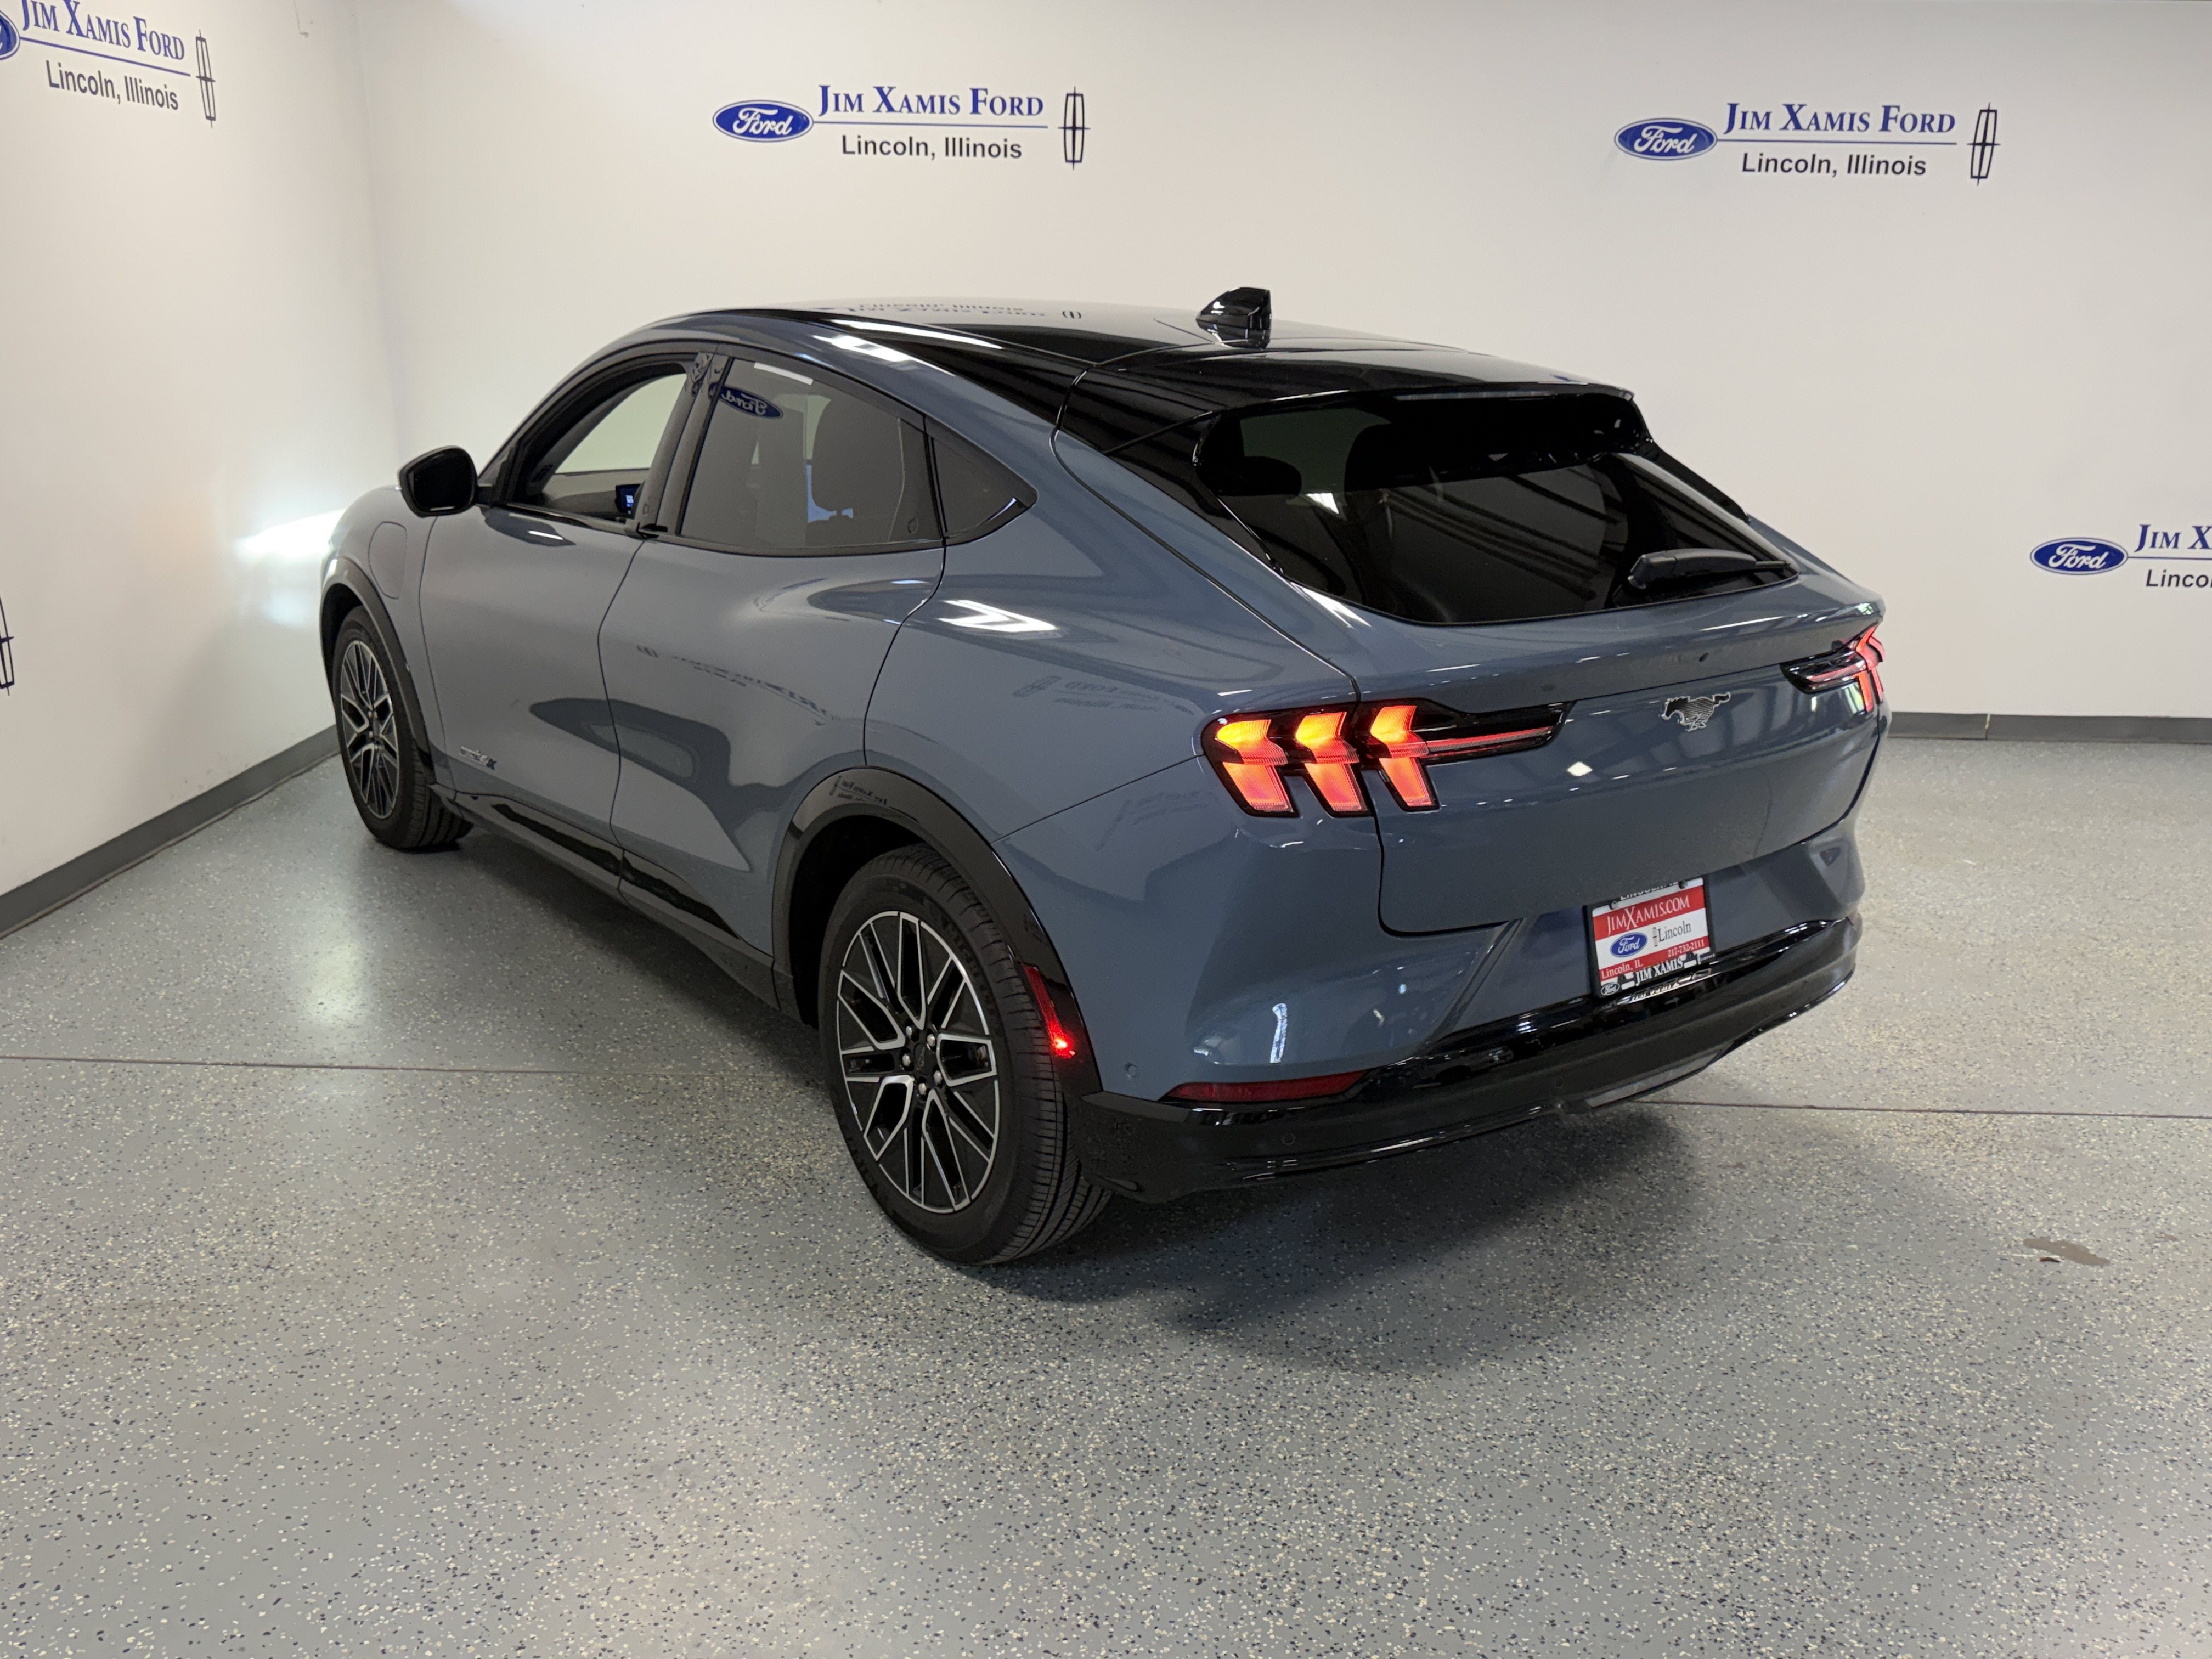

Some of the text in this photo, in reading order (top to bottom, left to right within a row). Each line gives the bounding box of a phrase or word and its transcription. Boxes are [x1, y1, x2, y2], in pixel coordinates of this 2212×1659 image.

[21, 0, 185, 60] JIM XAMIS FORD
[46, 60, 179, 111] Lincoln, Illinois
[818, 84, 1044, 117] JIM XAMIS FORD
[732, 107, 794, 136] Ford
[1723, 103, 1955, 135] JIM XAMIS FORD
[842, 134, 1022, 161] Lincoln, Illinois
[1634, 125, 1698, 153] Ford
[1742, 152, 1926, 178] Lincoln, Illinois
[2134, 524, 2181, 553] JIM
[2047, 544, 2110, 569] Ford
[1618, 936, 1640, 954] Ford
[1657, 921, 1692, 943] Lincoln
[1667, 939, 1705, 958] 217-732-2111
[1601, 959, 1644, 980] Lincoln, IL
[1635, 958, 1683, 986] JIM XAMIS
